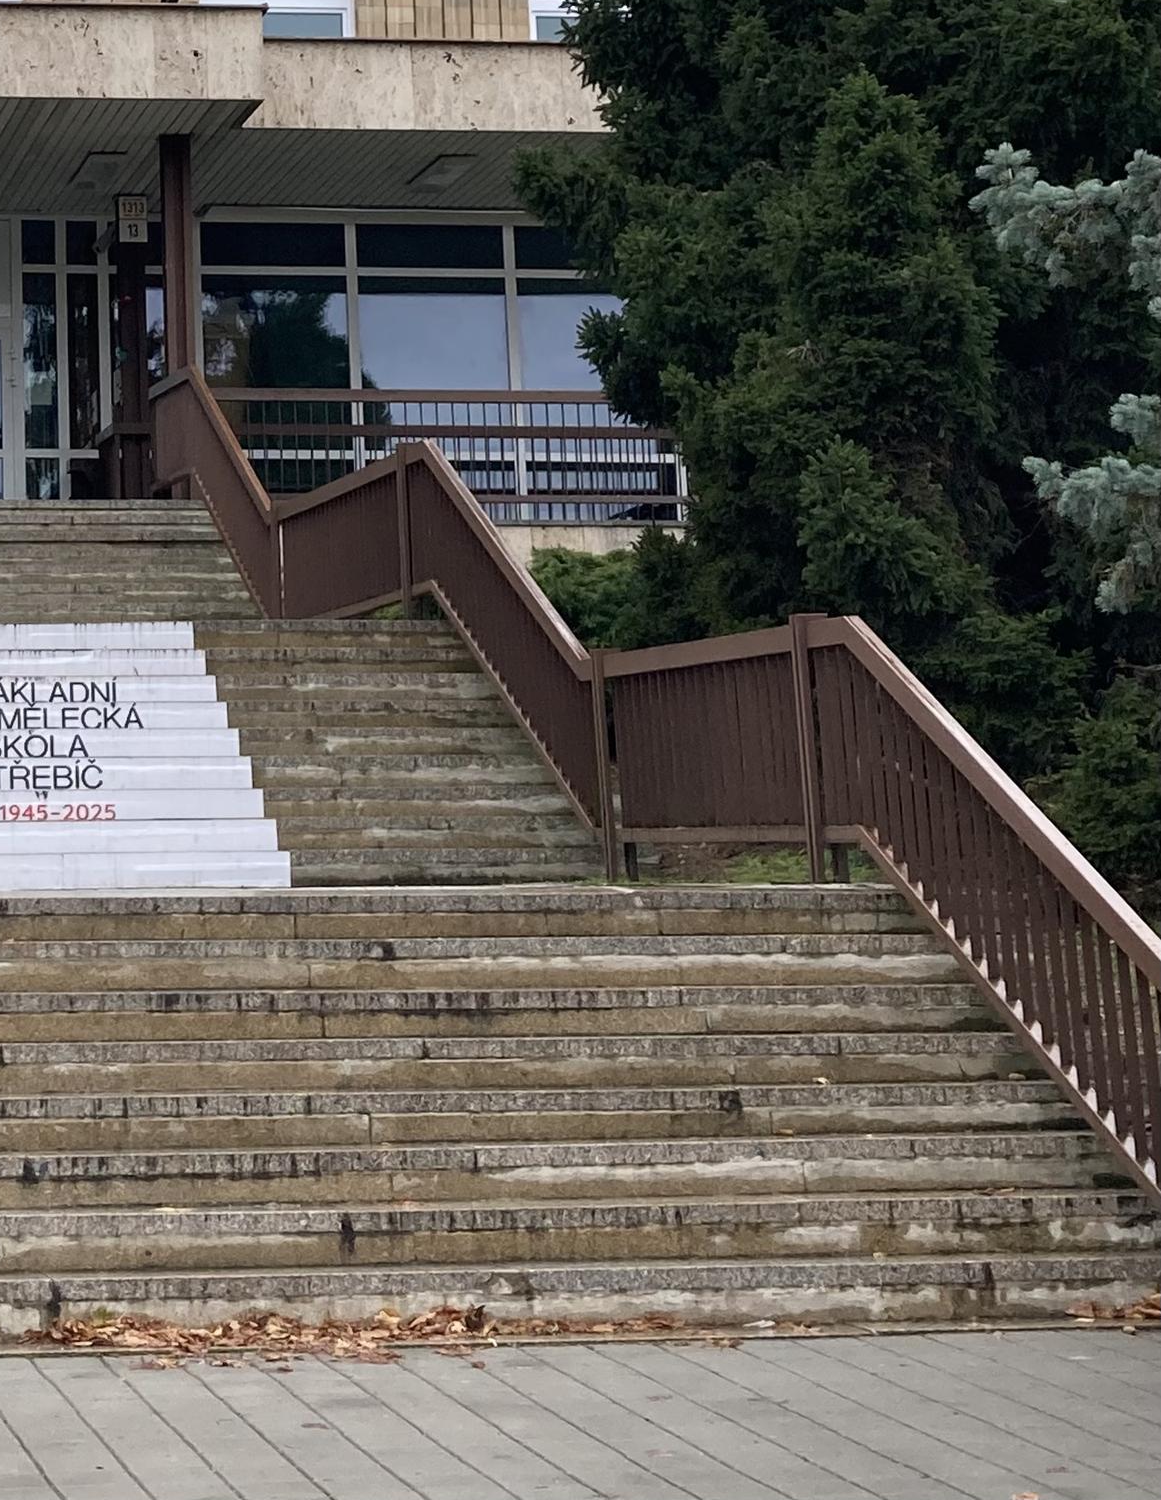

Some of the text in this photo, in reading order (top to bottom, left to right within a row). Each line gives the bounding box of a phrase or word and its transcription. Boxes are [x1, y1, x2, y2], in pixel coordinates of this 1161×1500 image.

[121, 202, 145, 213] 1313
[128, 223, 139, 237] 13
[0, 804, 116, 821] 1945-2025
